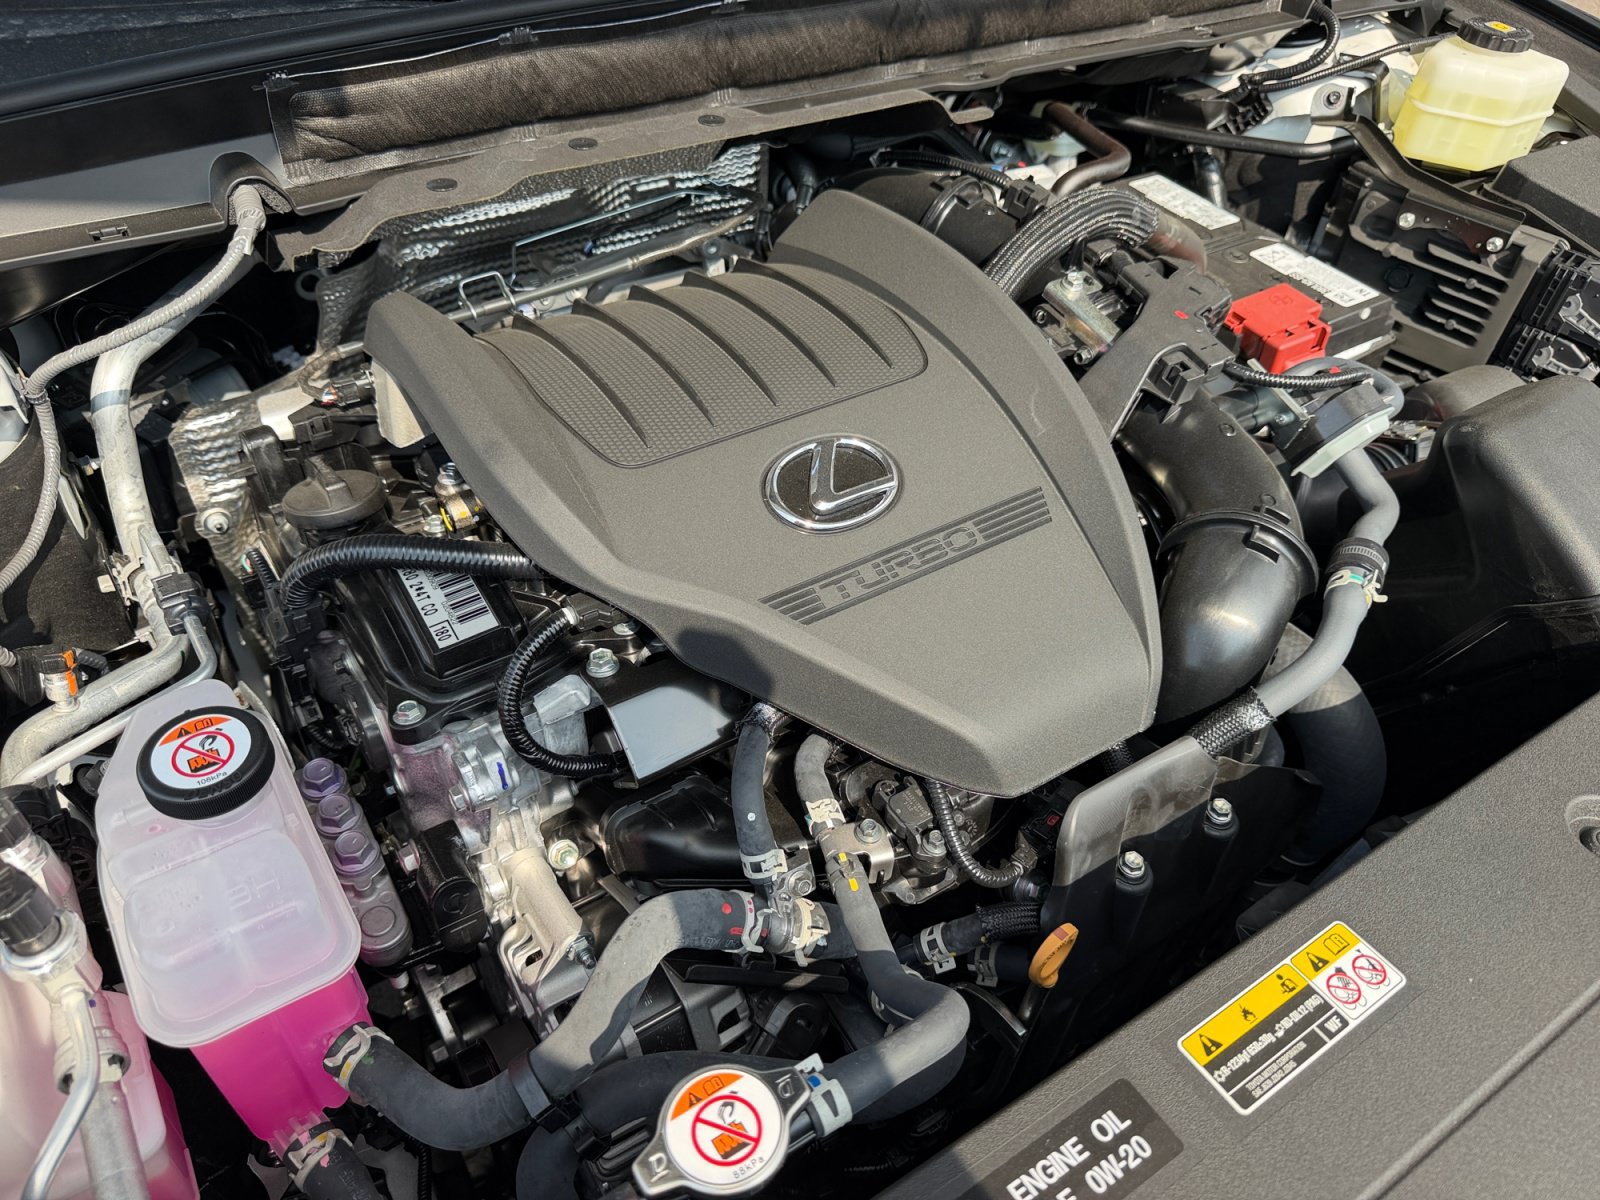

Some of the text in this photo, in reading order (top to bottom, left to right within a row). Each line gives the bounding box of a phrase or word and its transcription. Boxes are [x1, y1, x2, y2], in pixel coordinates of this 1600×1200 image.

[818, 526, 978, 600] TURBO
[402, 569, 419, 581] 80
[433, 626, 452, 642] 180
[197, 771, 228, 786] 108kPa
[1324, 1016, 1344, 1034] WF
[732, 1156, 765, 1179] 88kPa
[1006, 1109, 1133, 1200] ENGINE OIL
[1084, 1135, 1153, 1194] 0W-20
